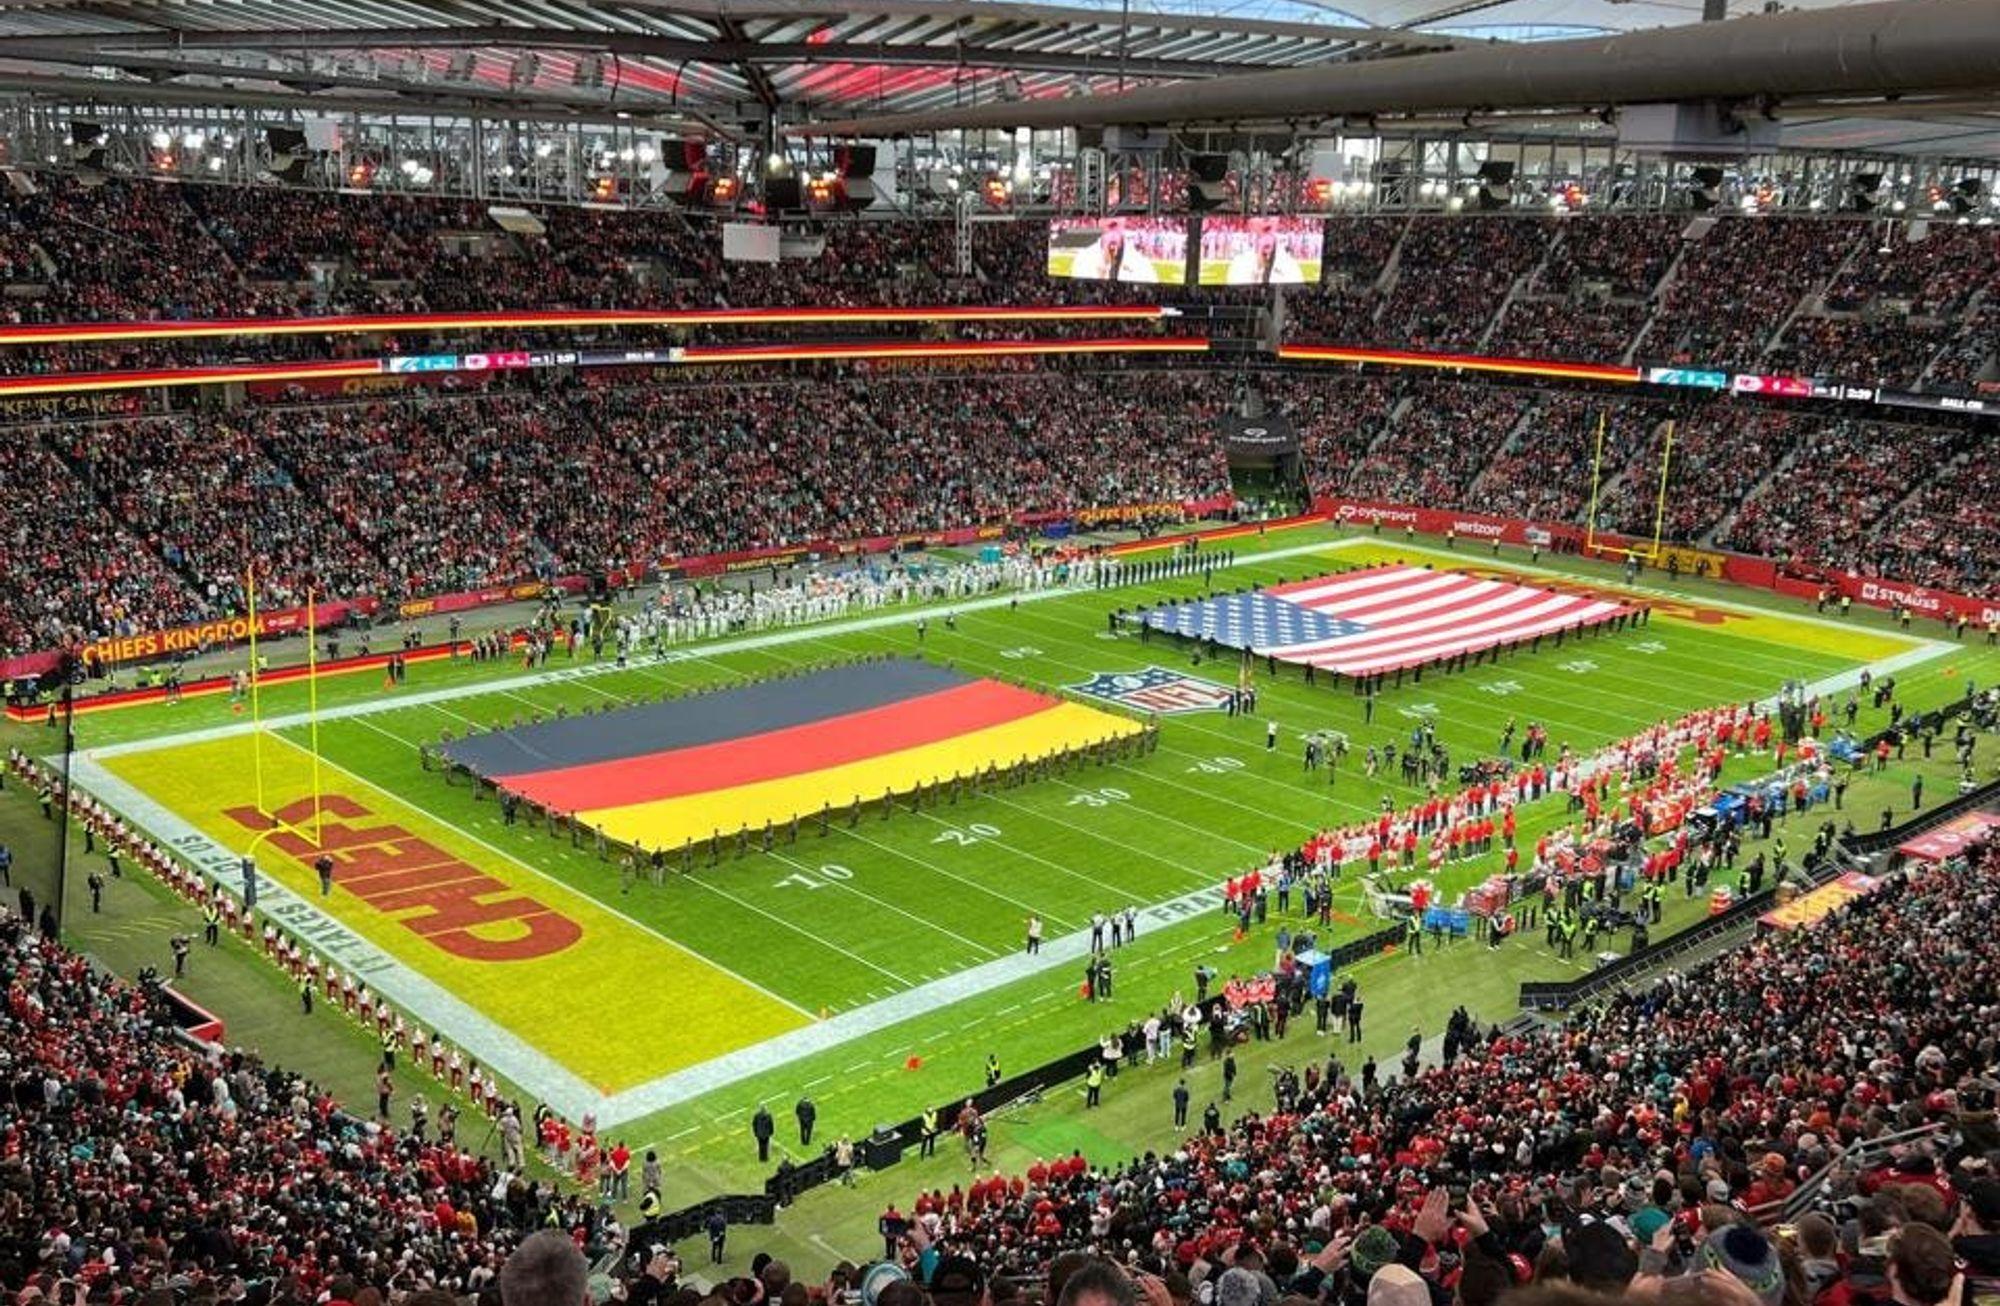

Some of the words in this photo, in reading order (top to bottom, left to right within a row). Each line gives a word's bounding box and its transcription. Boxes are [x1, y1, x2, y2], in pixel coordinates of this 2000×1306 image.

[1358, 507, 1418, 523] cyberport
[1453, 521, 1504, 537] verizon
[1879, 588, 1939, 611] STRAUSS
[82, 636, 158, 666] CHIEFS
[163, 618, 265, 650] KINGDOM
[1196, 757, 1246, 773] 40
[1073, 788, 1132, 807] 30
[171, 833, 214, 857] US
[941, 823, 1002, 846] 20
[221, 793, 583, 962] CHIEFS
[789, 864, 854, 890] 10
[272, 902, 361, 954] TAKES
